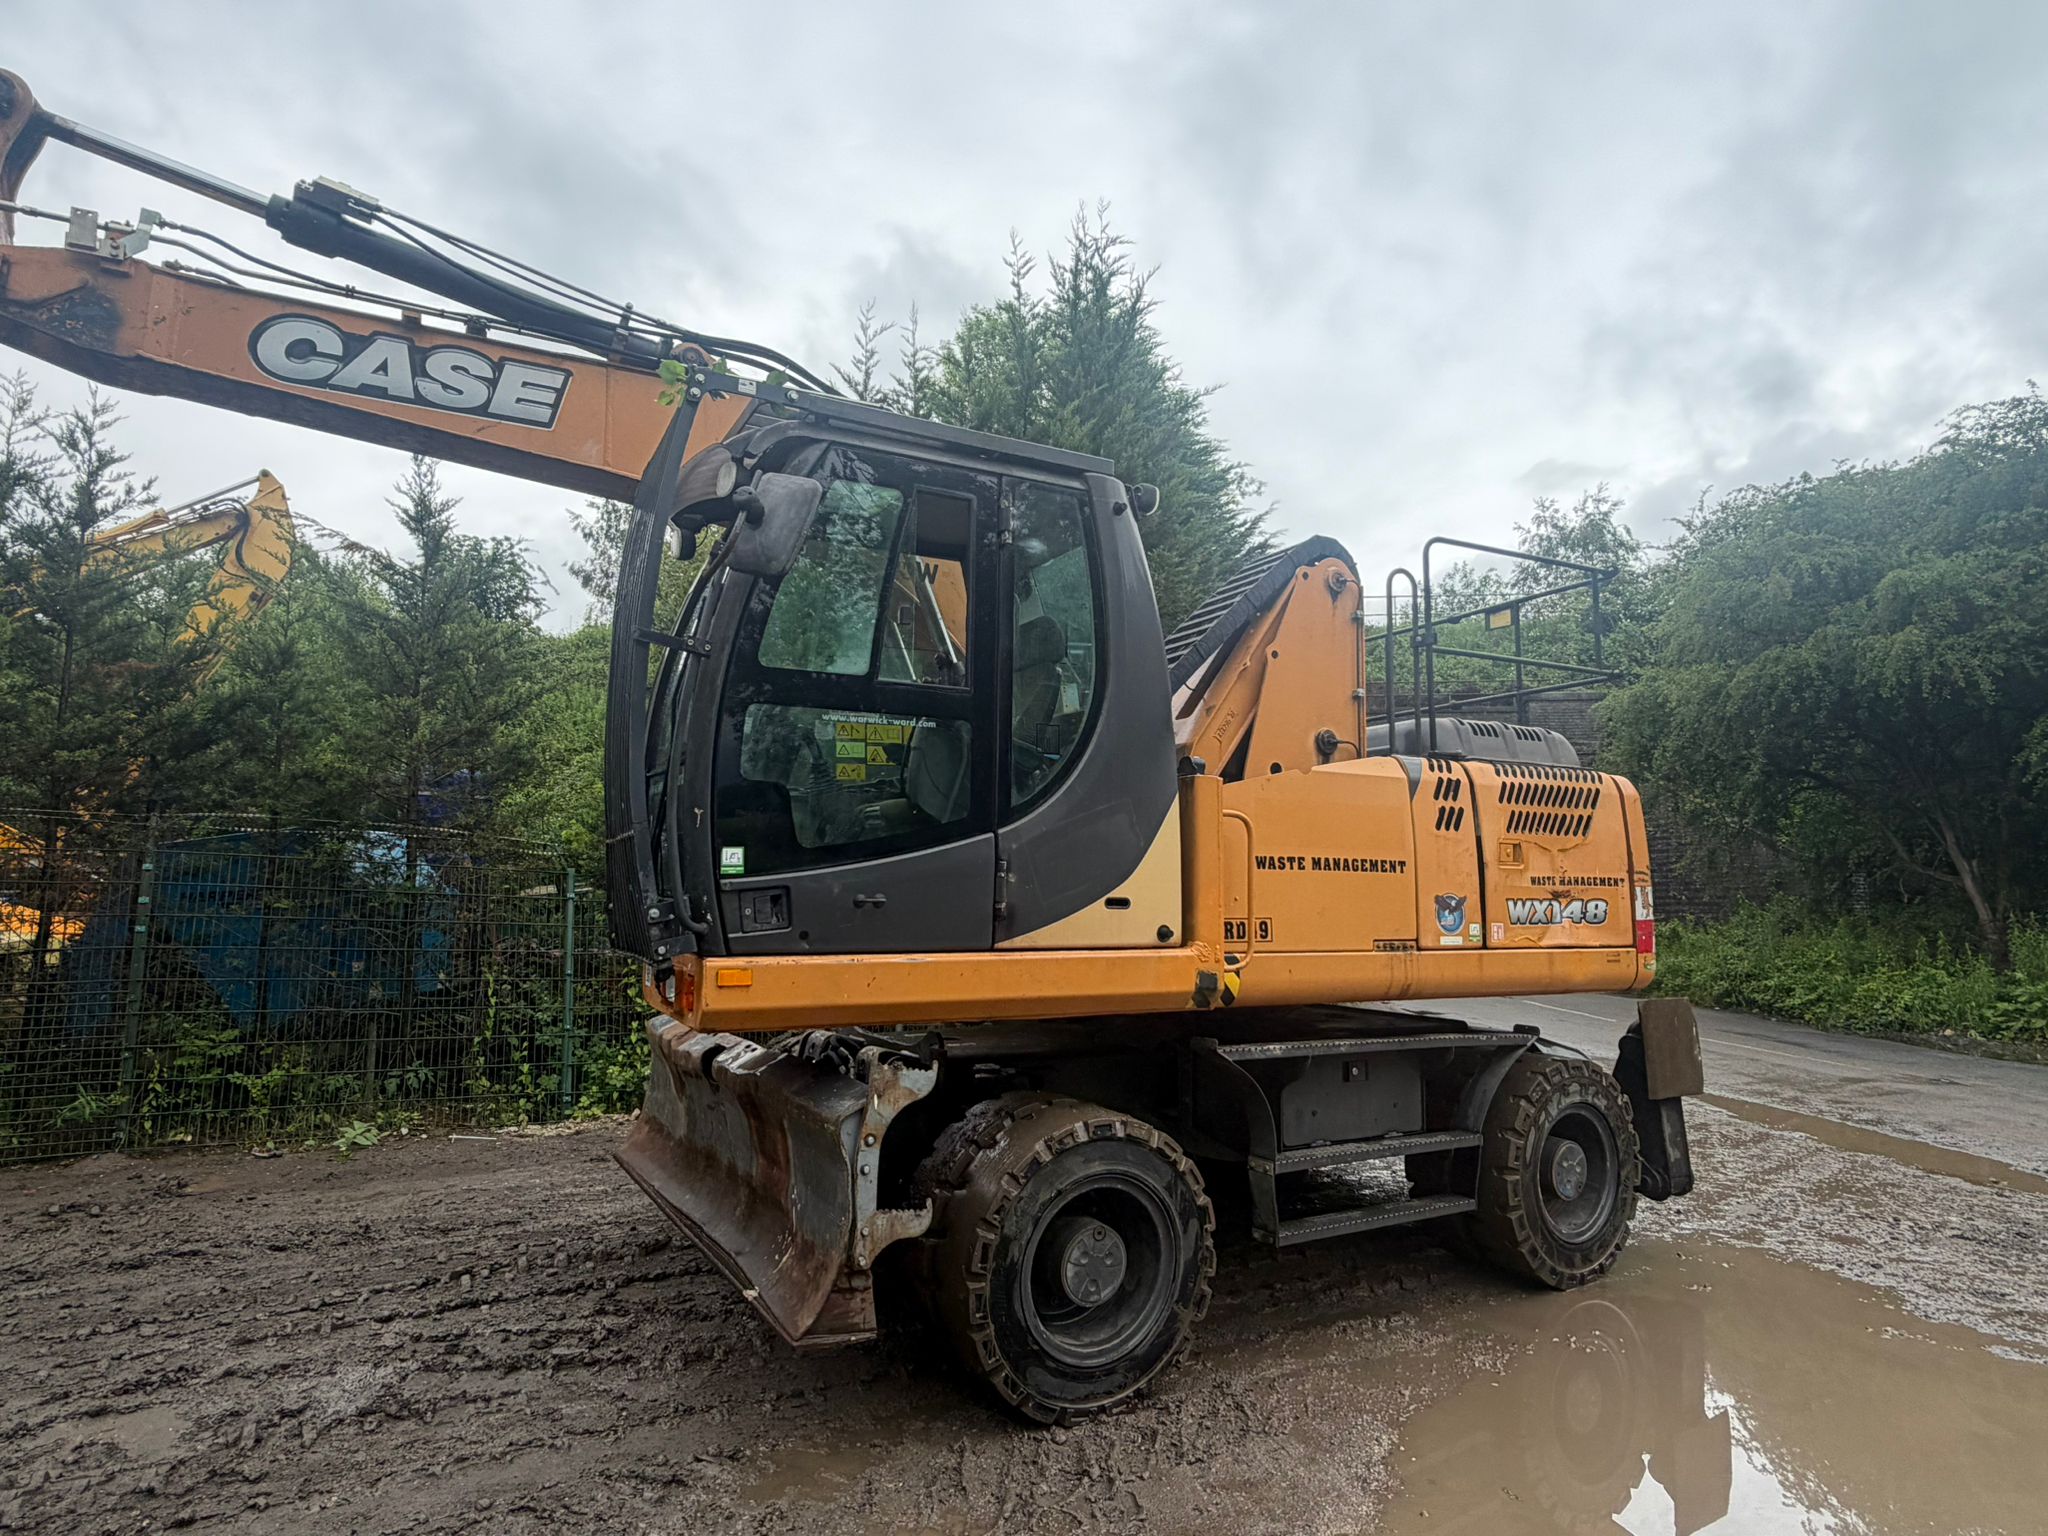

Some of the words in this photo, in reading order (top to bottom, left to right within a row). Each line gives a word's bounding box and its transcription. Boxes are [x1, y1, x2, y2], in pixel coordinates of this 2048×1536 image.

[256, 316, 566, 424] CASE
[821, 713, 937, 729] www.warwick-ward.com
[1255, 856, 1305, 870] WASTE
[1311, 857, 1407, 873] MANAGEMENT
[1530, 876, 1556, 887] WASTE
[1558, 876, 1625, 888] MANAGEMENT
[1505, 898, 1608, 925] WX148
